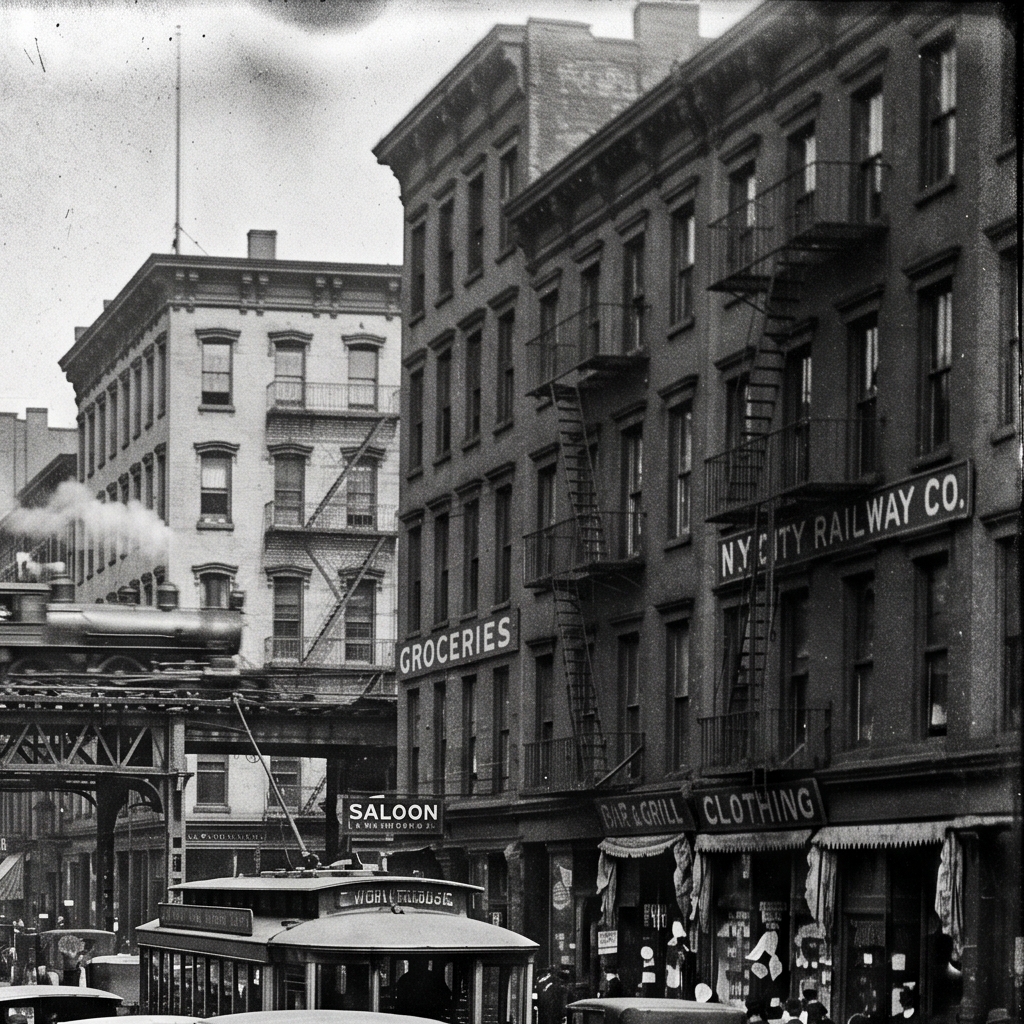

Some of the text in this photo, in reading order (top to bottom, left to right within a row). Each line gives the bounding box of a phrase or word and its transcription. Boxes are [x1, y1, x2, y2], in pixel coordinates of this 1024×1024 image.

[814, 485, 915, 549] RAILWAY
[924, 473, 965, 517] CO.
[399, 616, 511, 674] GROCERIES
[349, 803, 438, 820] SALOON
[601, 798, 684, 830] BAR & GRILL
[703, 787, 815, 826] CLOTHING
